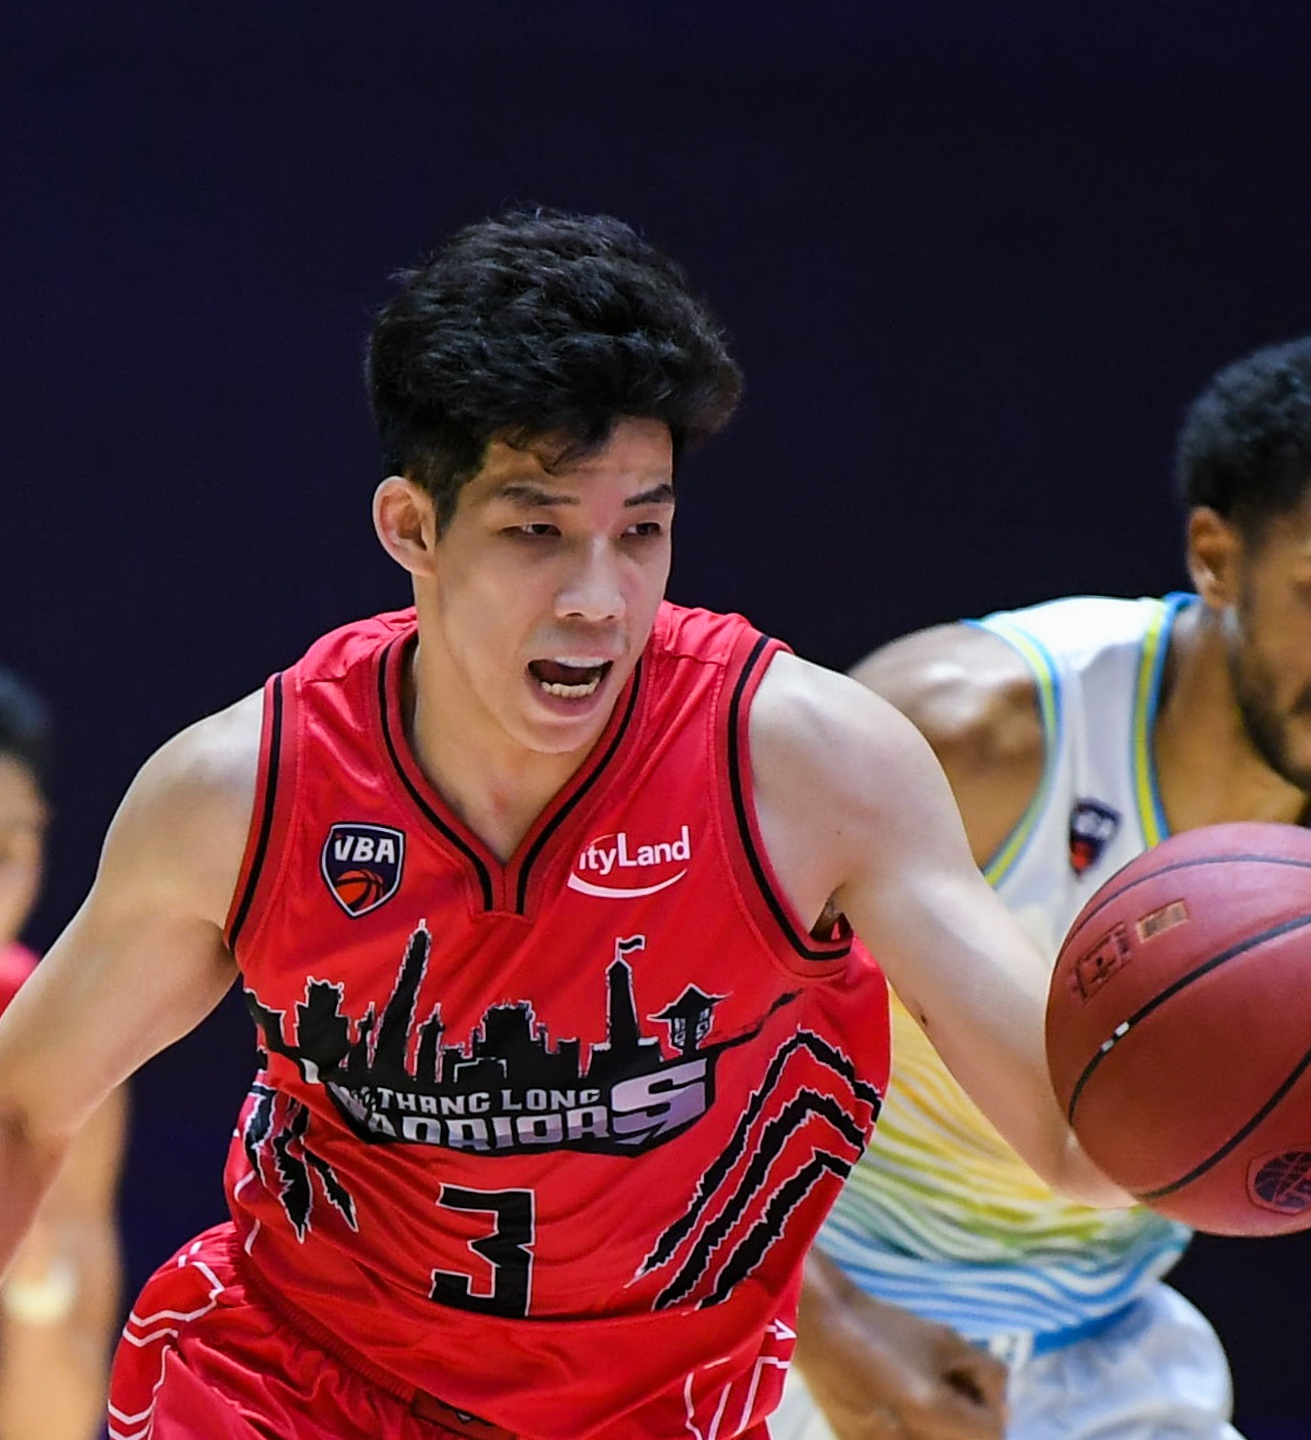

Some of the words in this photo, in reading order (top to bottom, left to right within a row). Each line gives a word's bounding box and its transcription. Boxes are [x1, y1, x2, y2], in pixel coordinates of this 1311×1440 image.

[334, 835, 396, 864] VBA
[377, 1086, 491, 1115] THANG
[498, 1088, 601, 1111] LONG
[430, 1184, 536, 1316] 3
